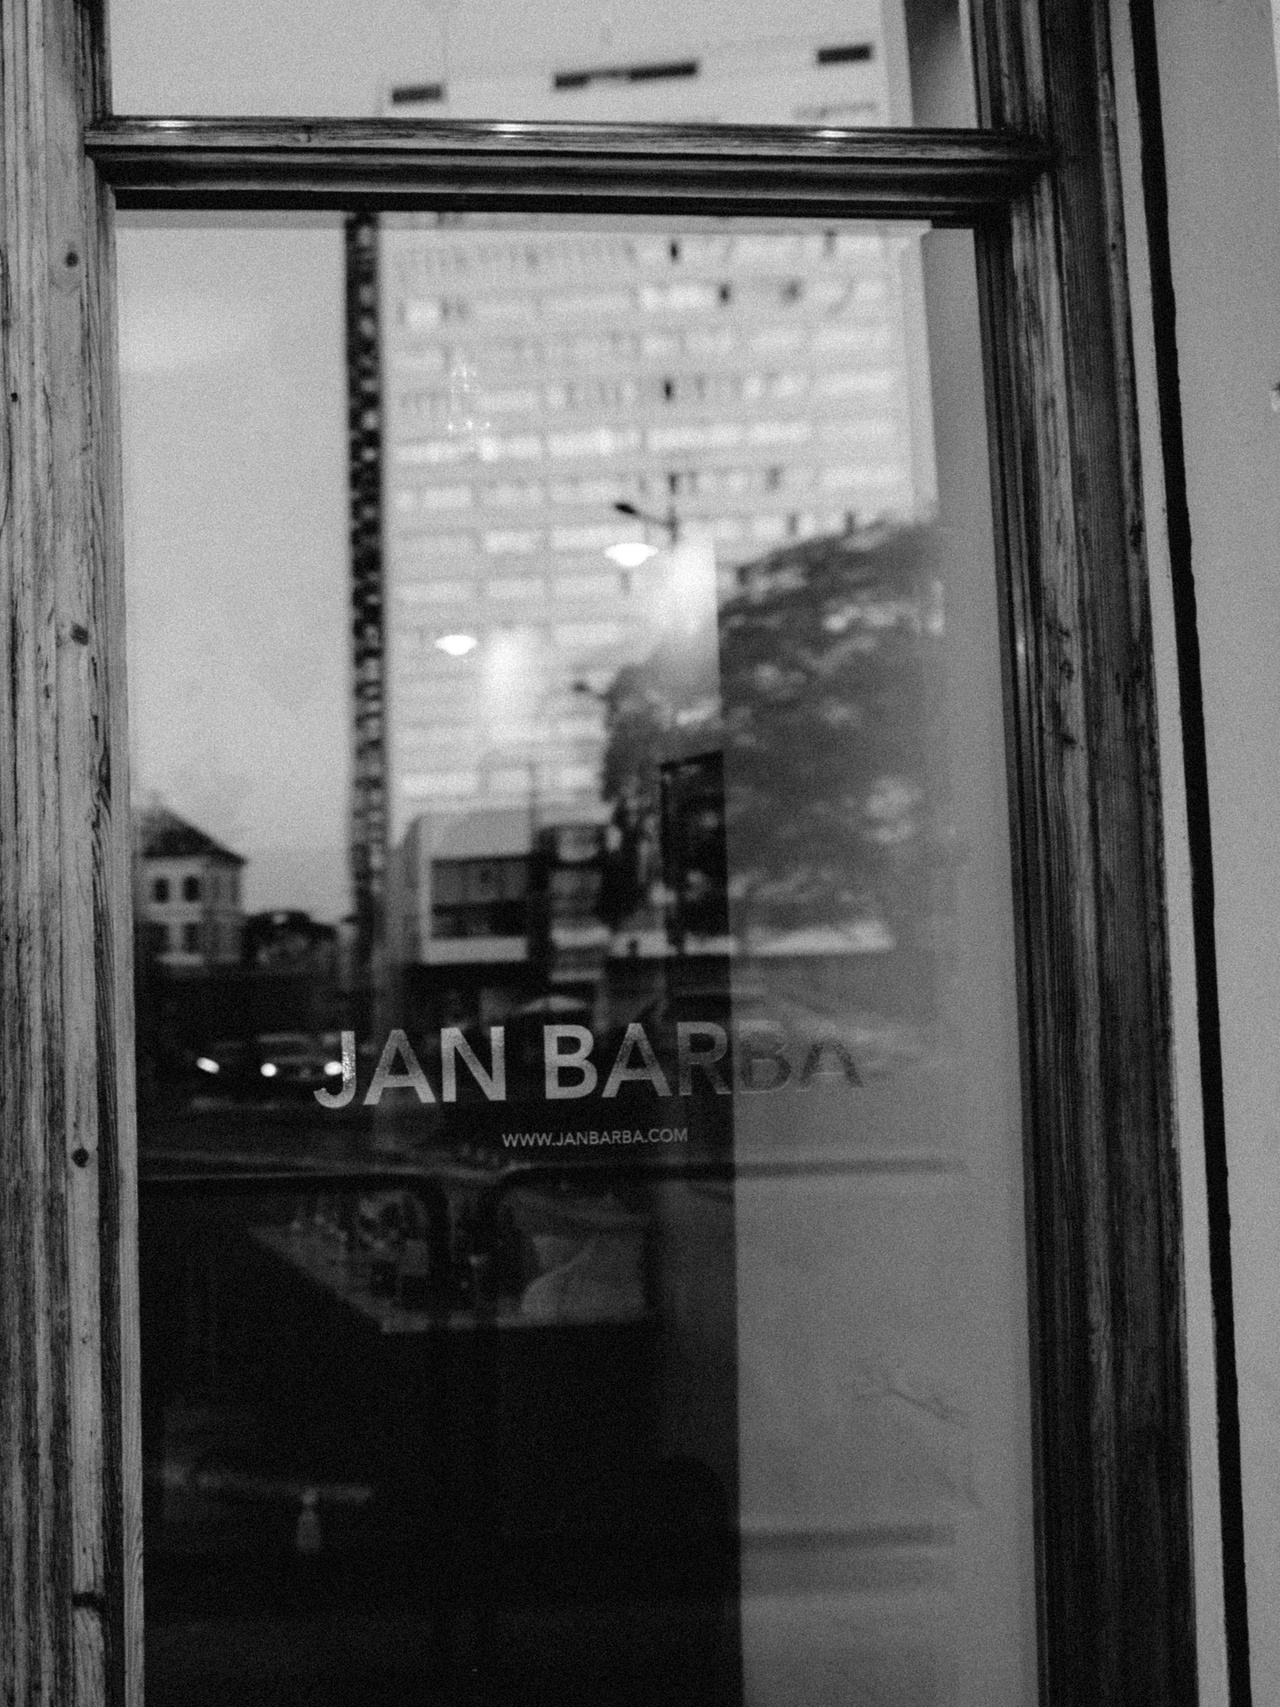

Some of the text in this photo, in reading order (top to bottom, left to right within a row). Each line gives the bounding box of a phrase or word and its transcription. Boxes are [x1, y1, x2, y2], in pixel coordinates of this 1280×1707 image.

[313, 1019, 865, 1108] JAN BARBA
[502, 1128, 688, 1147] WWW.JANBARBA.COM
